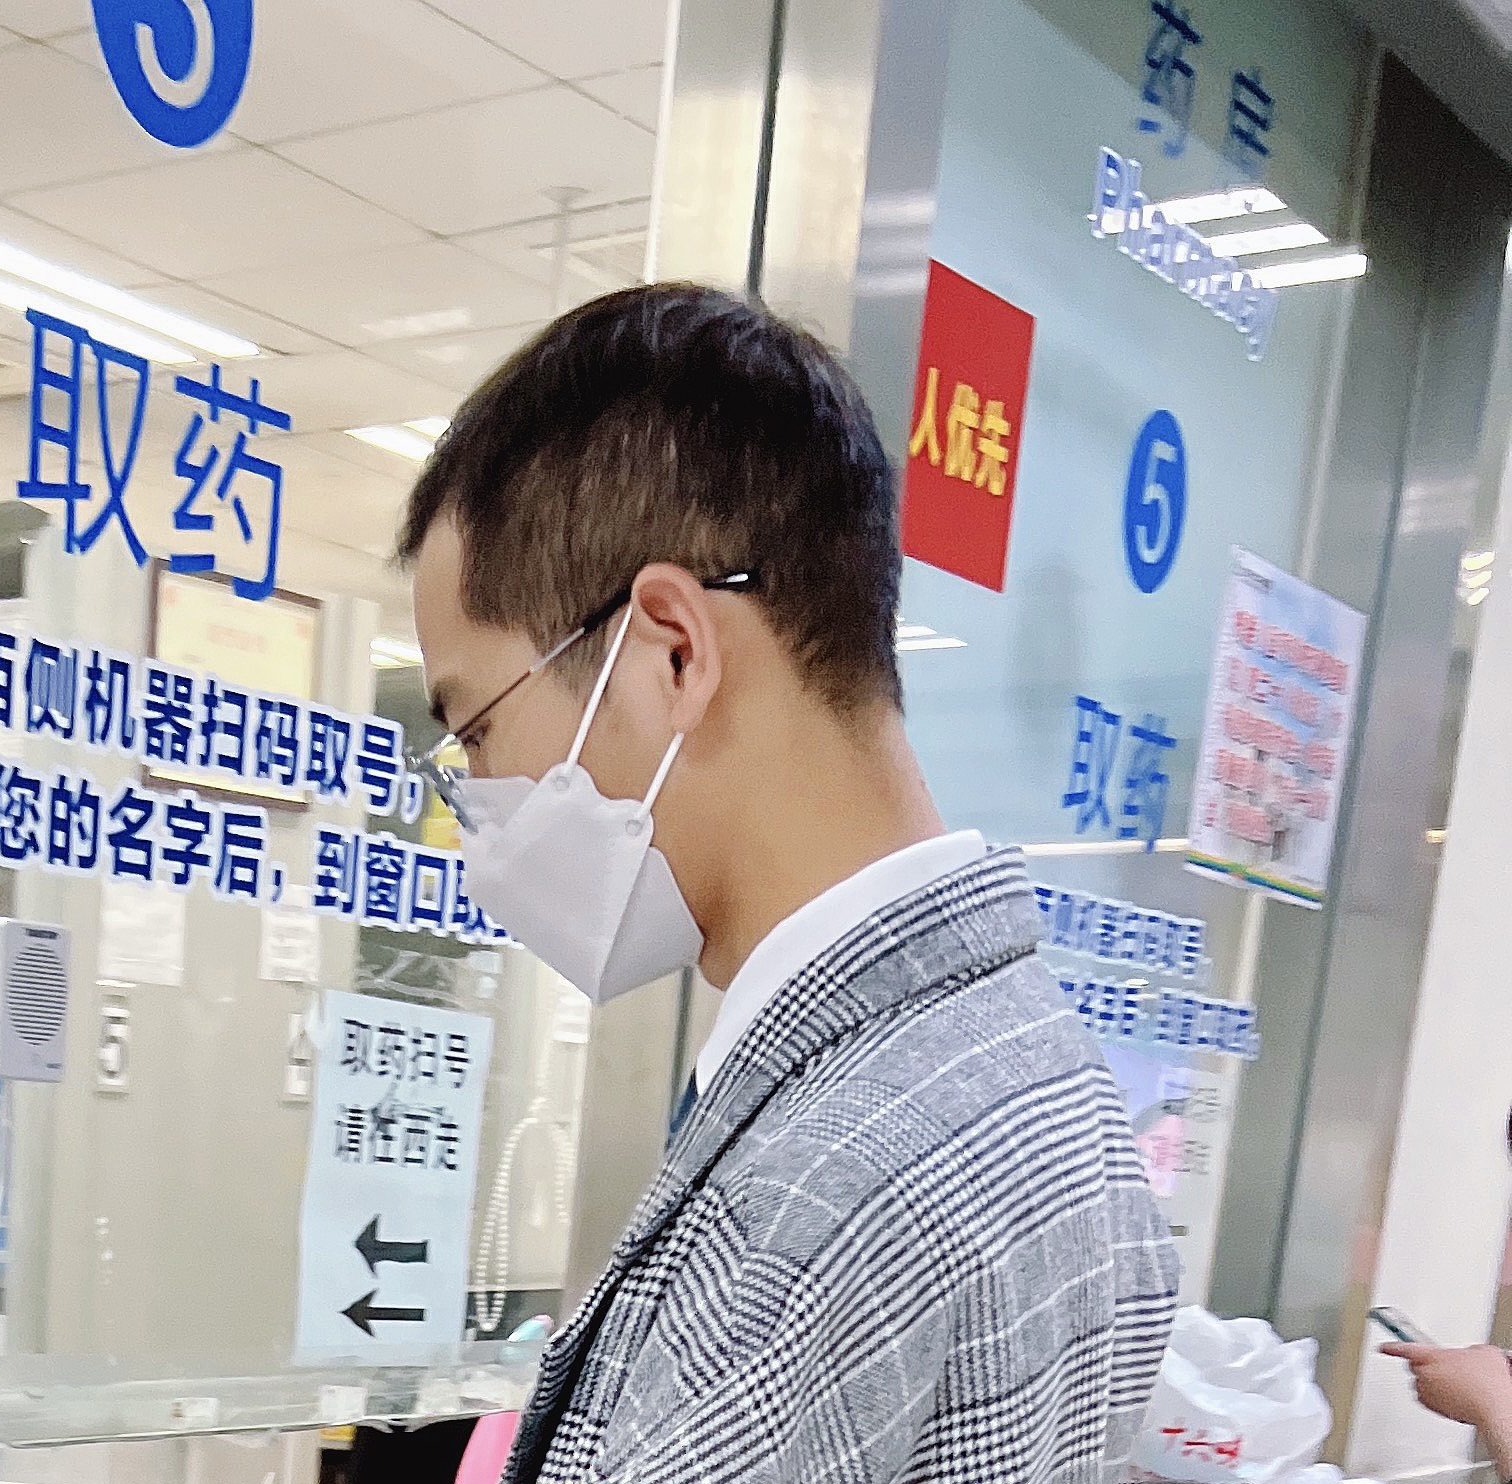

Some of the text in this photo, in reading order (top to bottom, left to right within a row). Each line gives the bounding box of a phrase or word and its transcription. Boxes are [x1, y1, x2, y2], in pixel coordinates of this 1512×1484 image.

[17, 307, 290, 600] 取药
[909, 367, 1012, 496] 人优先
[1134, 440, 1176, 565] 5
[1061, 695, 1177, 853] 取药
[99, 1015, 129, 1080] 5
[340, 1017, 471, 1090] 取药扫号
